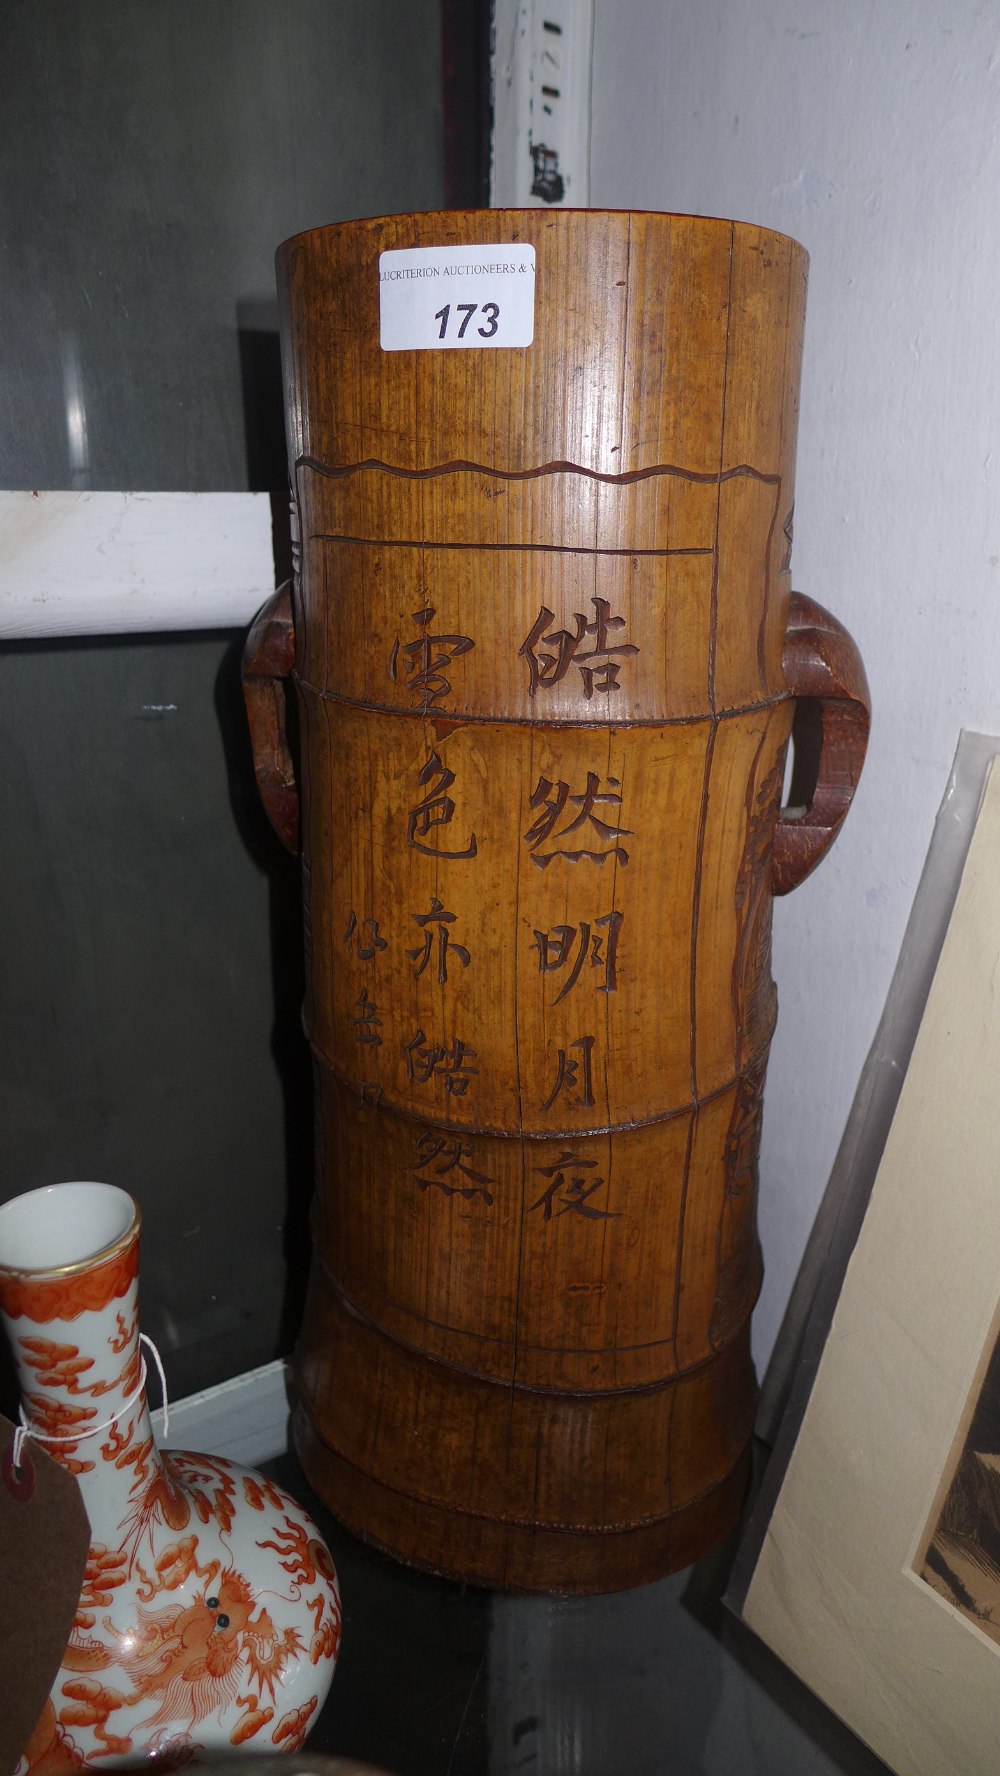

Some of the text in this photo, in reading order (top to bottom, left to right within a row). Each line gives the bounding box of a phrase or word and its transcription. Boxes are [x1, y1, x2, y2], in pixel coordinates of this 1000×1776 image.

[443, 263, 516, 276] AUCTIONEERS
[518, 263, 527, 273] &
[434, 302, 500, 339] 173
